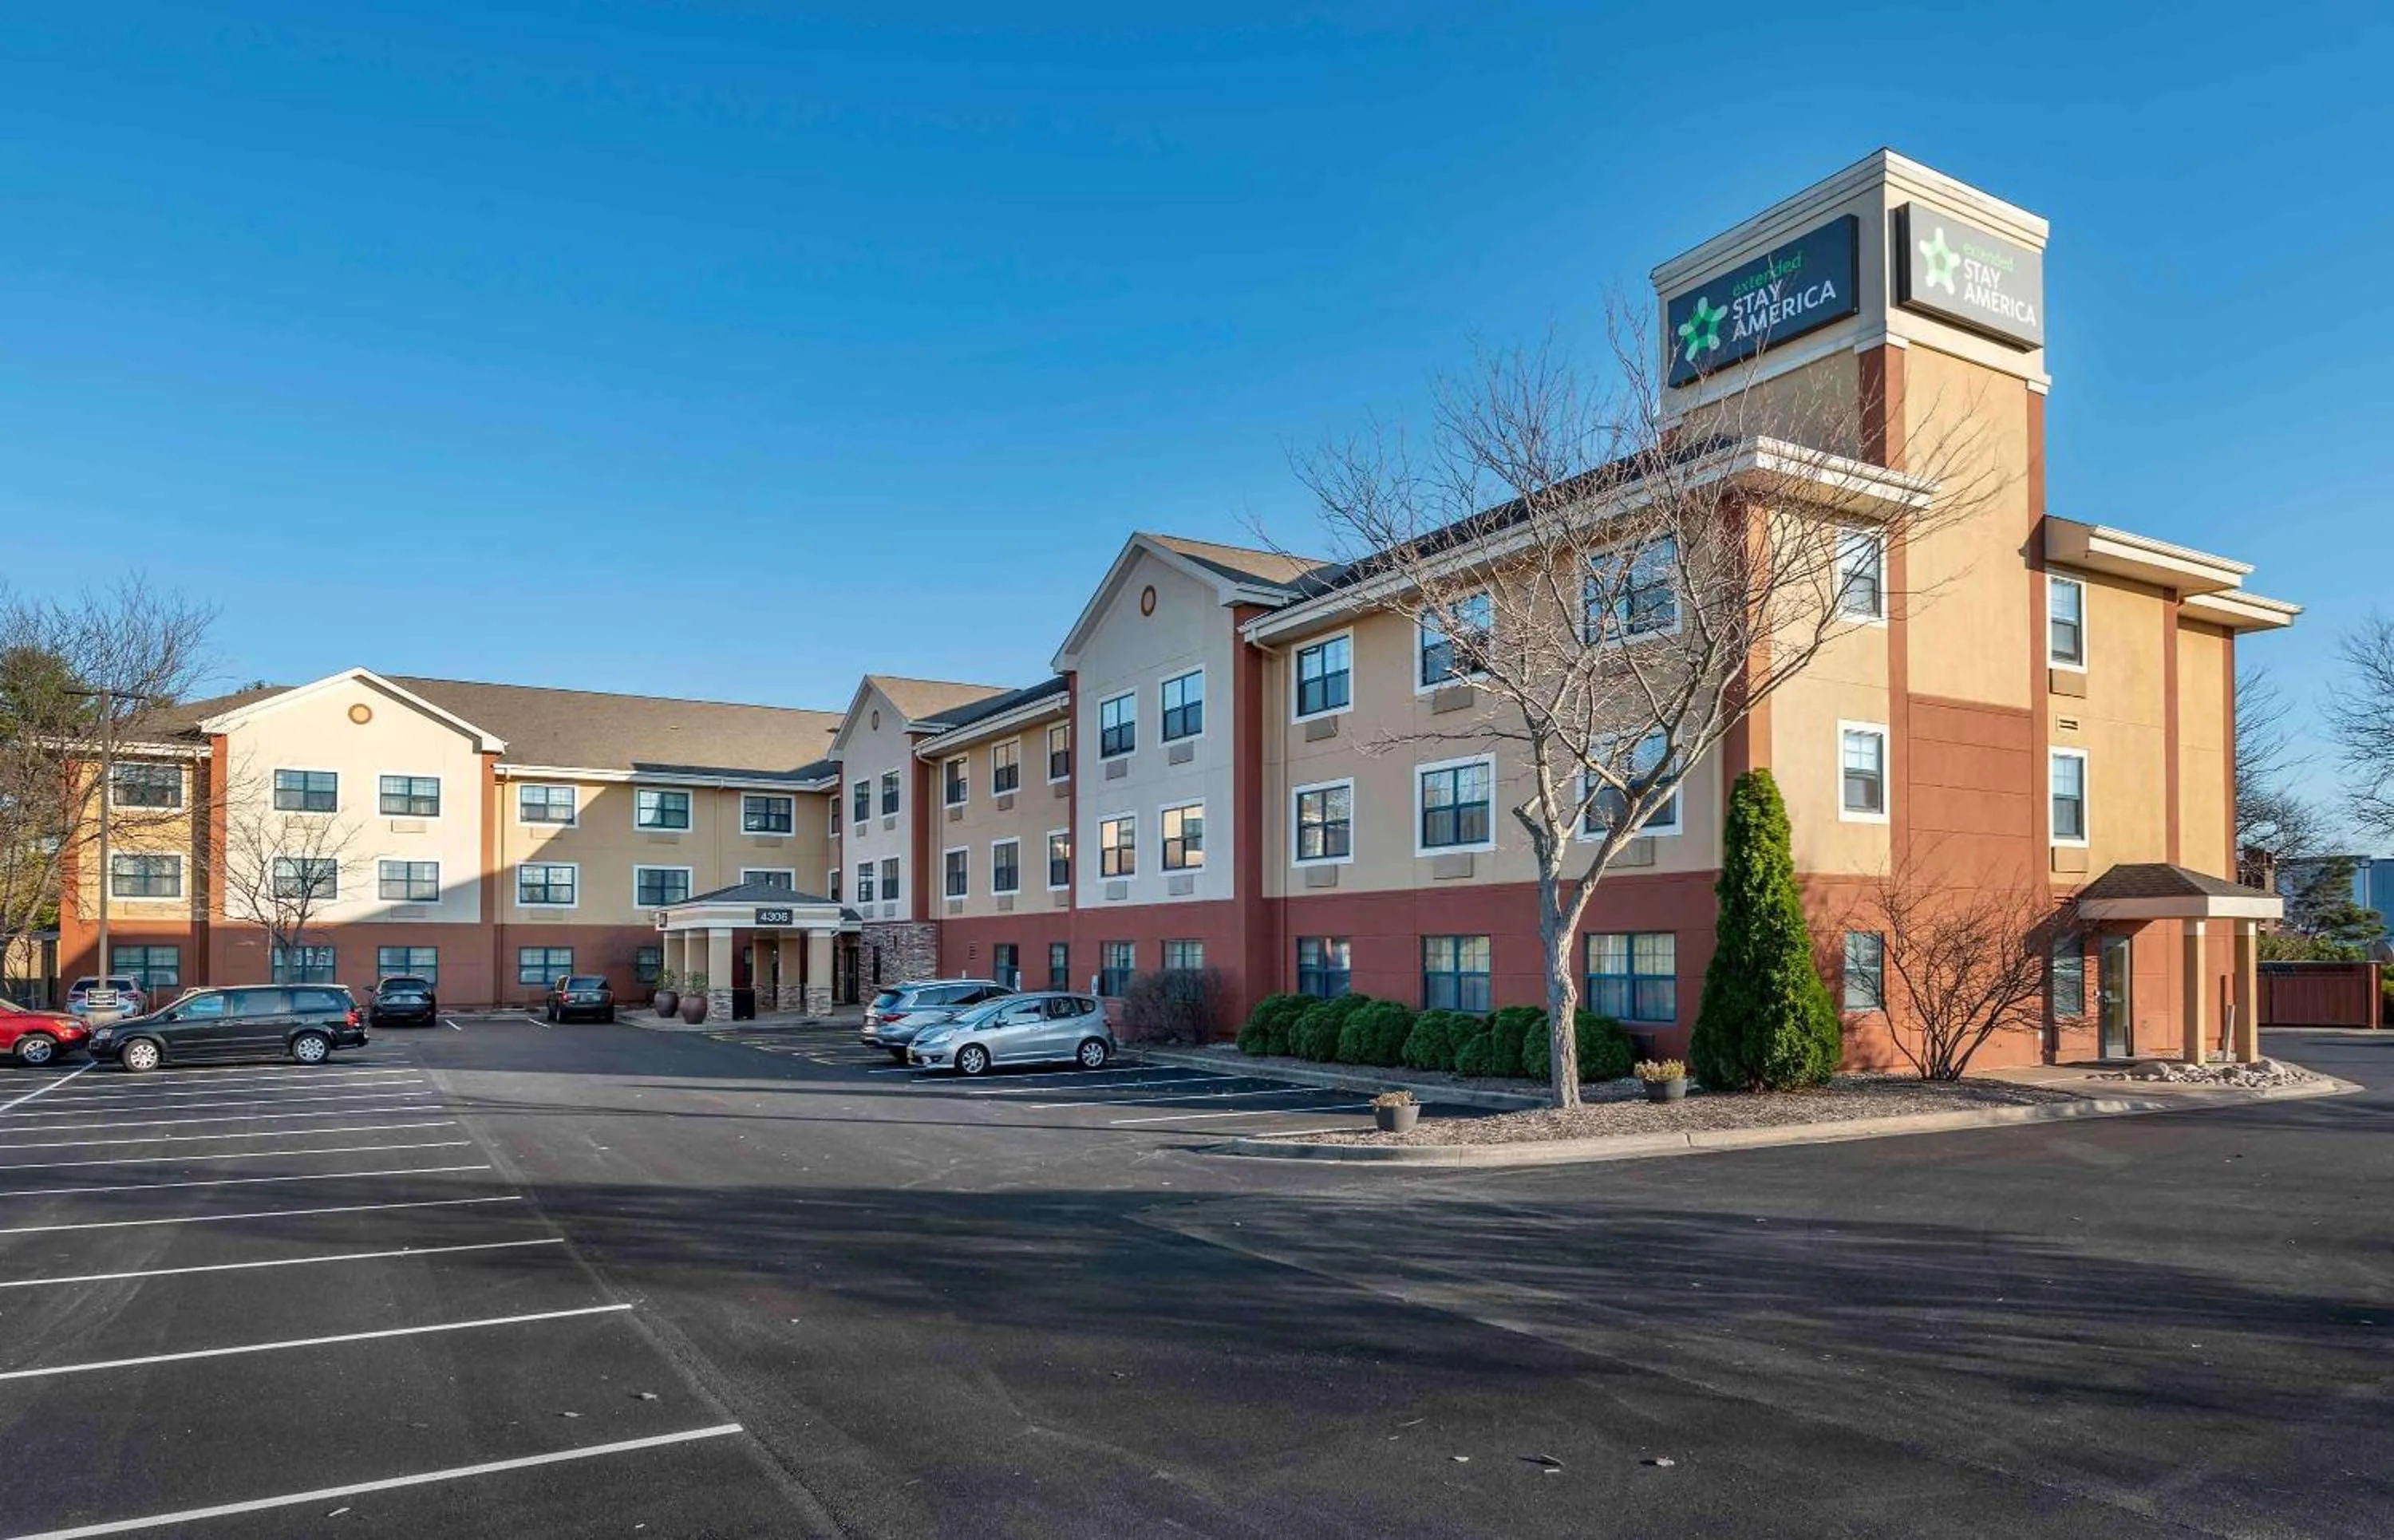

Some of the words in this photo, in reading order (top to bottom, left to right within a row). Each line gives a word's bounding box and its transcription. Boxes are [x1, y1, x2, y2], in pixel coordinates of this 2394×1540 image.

[1732, 250, 1802, 297] extended
[1964, 259, 2001, 289] STAY
[1731, 280, 1836, 342] AMERICA
[1732, 279, 1783, 319] STAY
[1963, 282, 2036, 326] AMERICA
